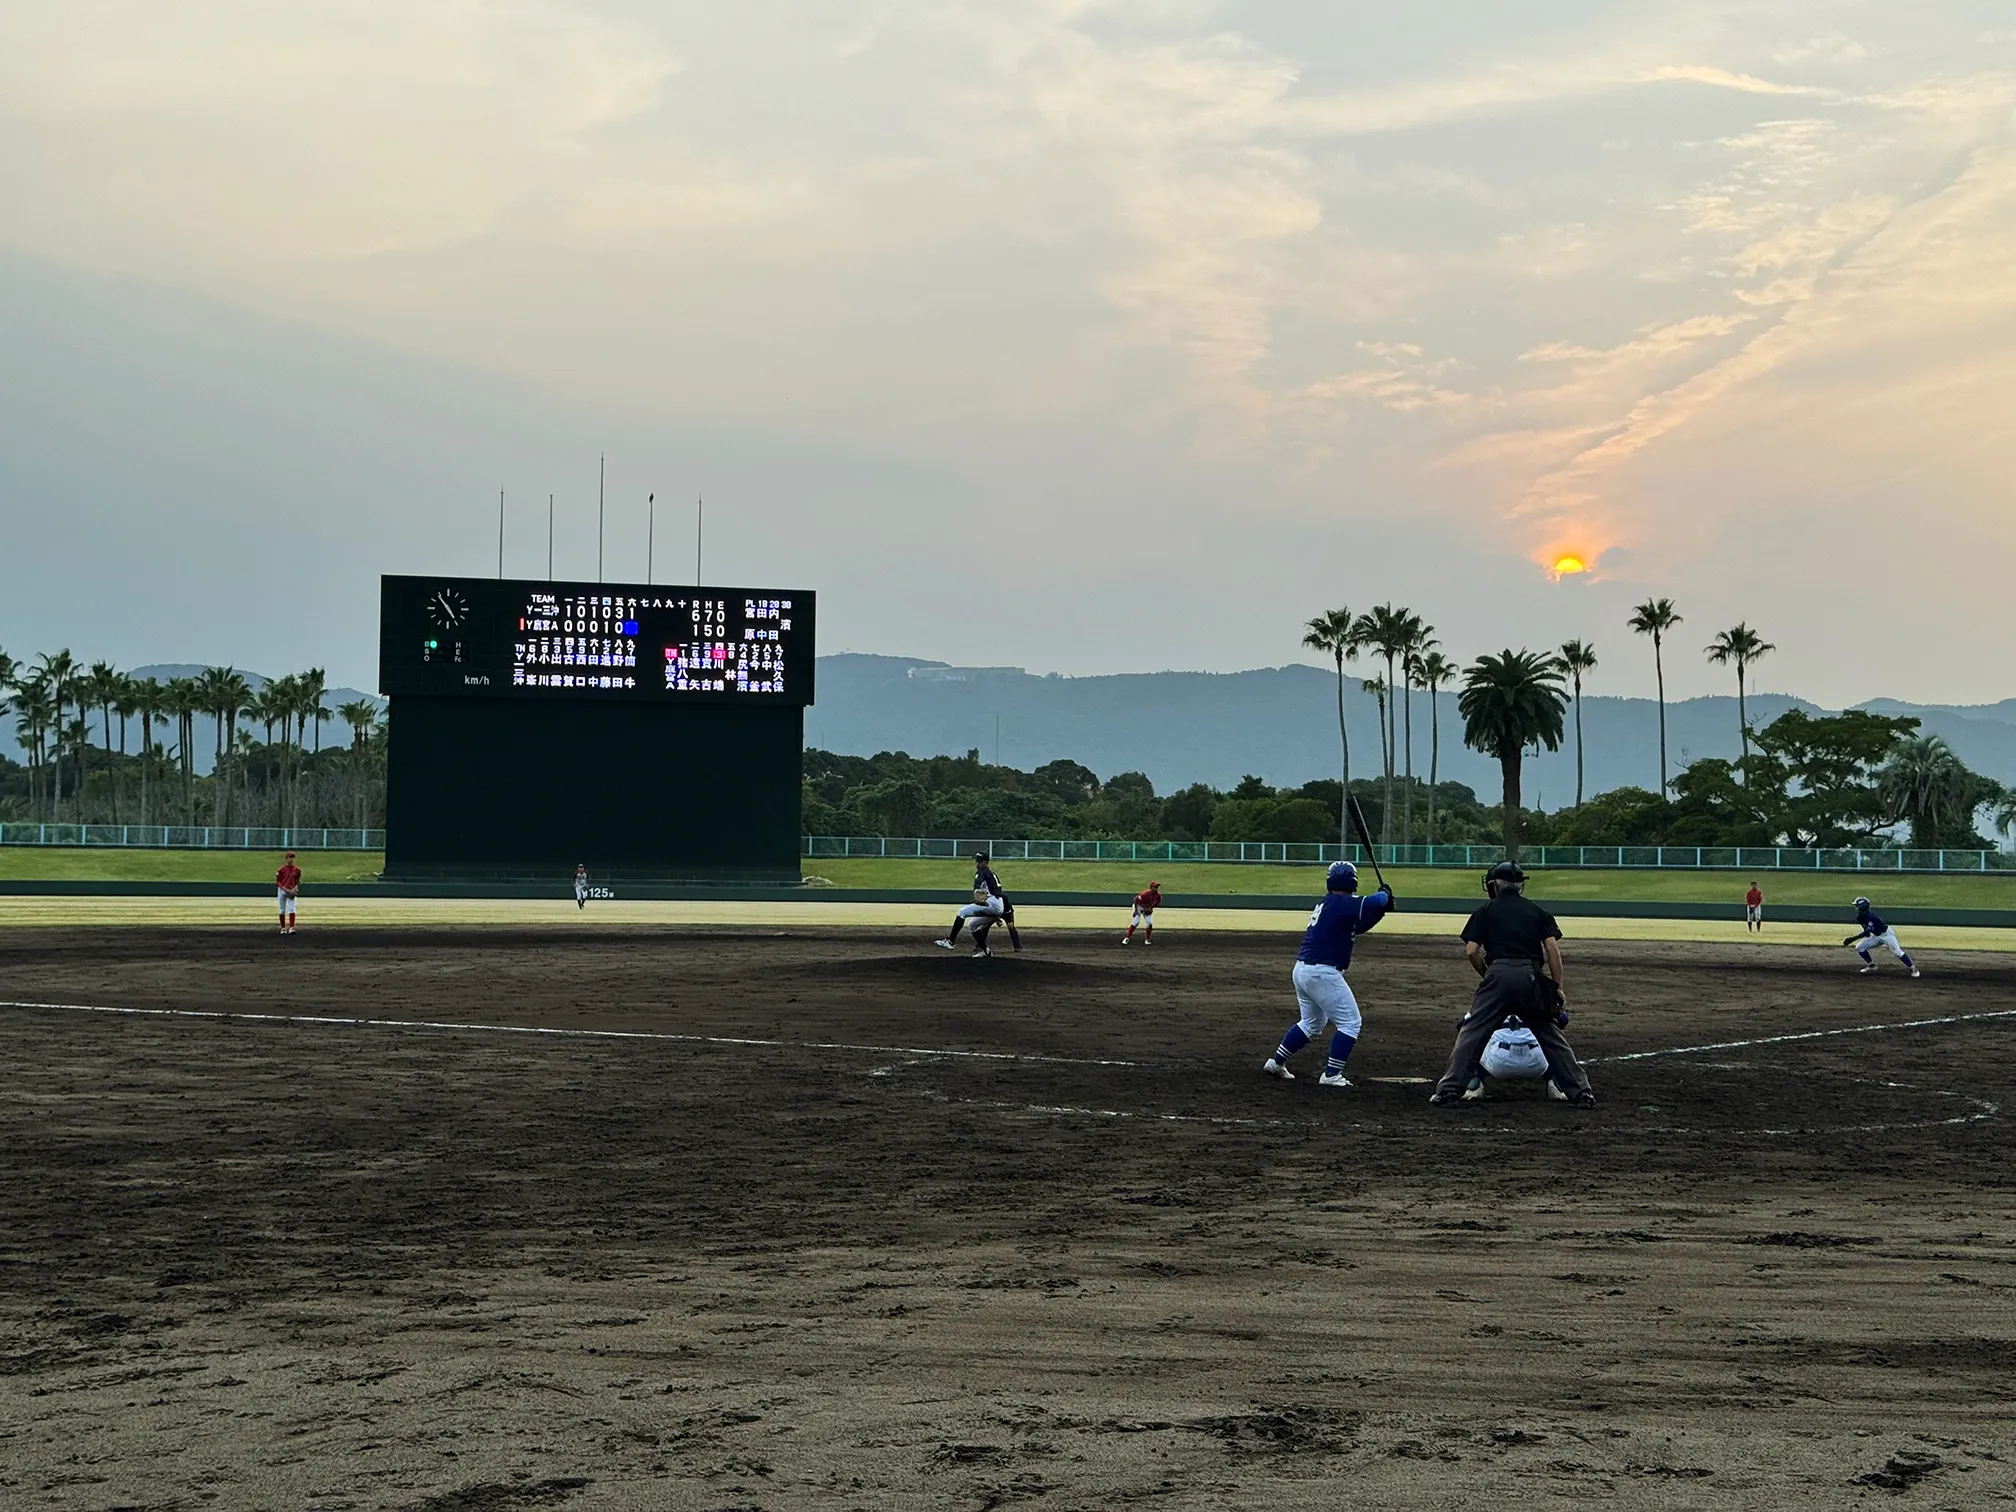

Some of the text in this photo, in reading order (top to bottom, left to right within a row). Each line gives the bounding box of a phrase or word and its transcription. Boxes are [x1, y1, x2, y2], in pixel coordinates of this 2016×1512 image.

[531, 595, 554, 603] TEAM
[693, 600, 724, 609] R H E
[746, 599, 755, 607] PL
[770, 600, 779, 608] 2B
[781, 601, 791, 609] 3B
[567, 605, 633, 619] 1 0 1 0 3 1
[692, 610, 725, 622] 6 7 0
[564, 620, 623, 634] 0 0 0 1 0
[694, 624, 724, 637] 1 5 0
[725, 669, 736, 680] 林
[464, 675, 490, 686] km/h
